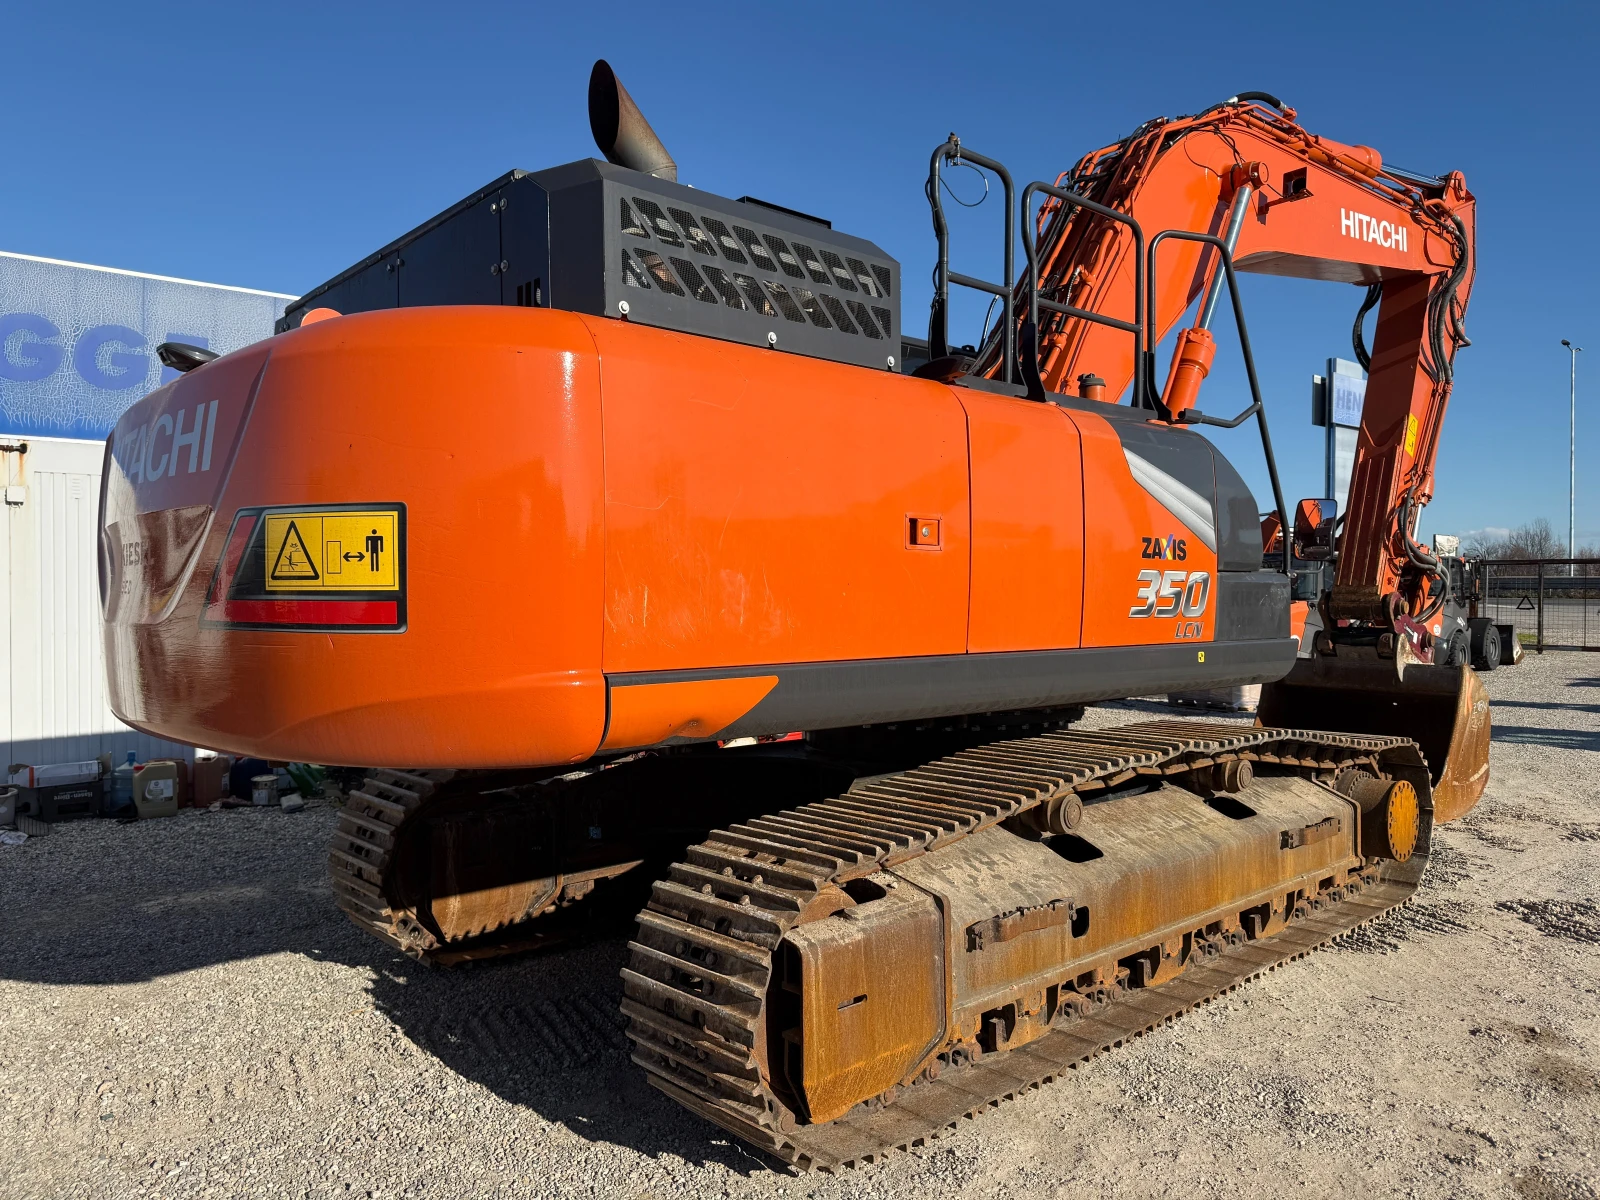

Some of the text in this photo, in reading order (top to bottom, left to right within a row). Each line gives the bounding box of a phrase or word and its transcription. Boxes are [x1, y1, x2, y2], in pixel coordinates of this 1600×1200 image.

[1340, 207, 1408, 253] HITACHI
[1142, 534, 1187, 561] ZAXIS
[1128, 569, 1210, 618] 350
[1175, 621, 1204, 639] LCN
